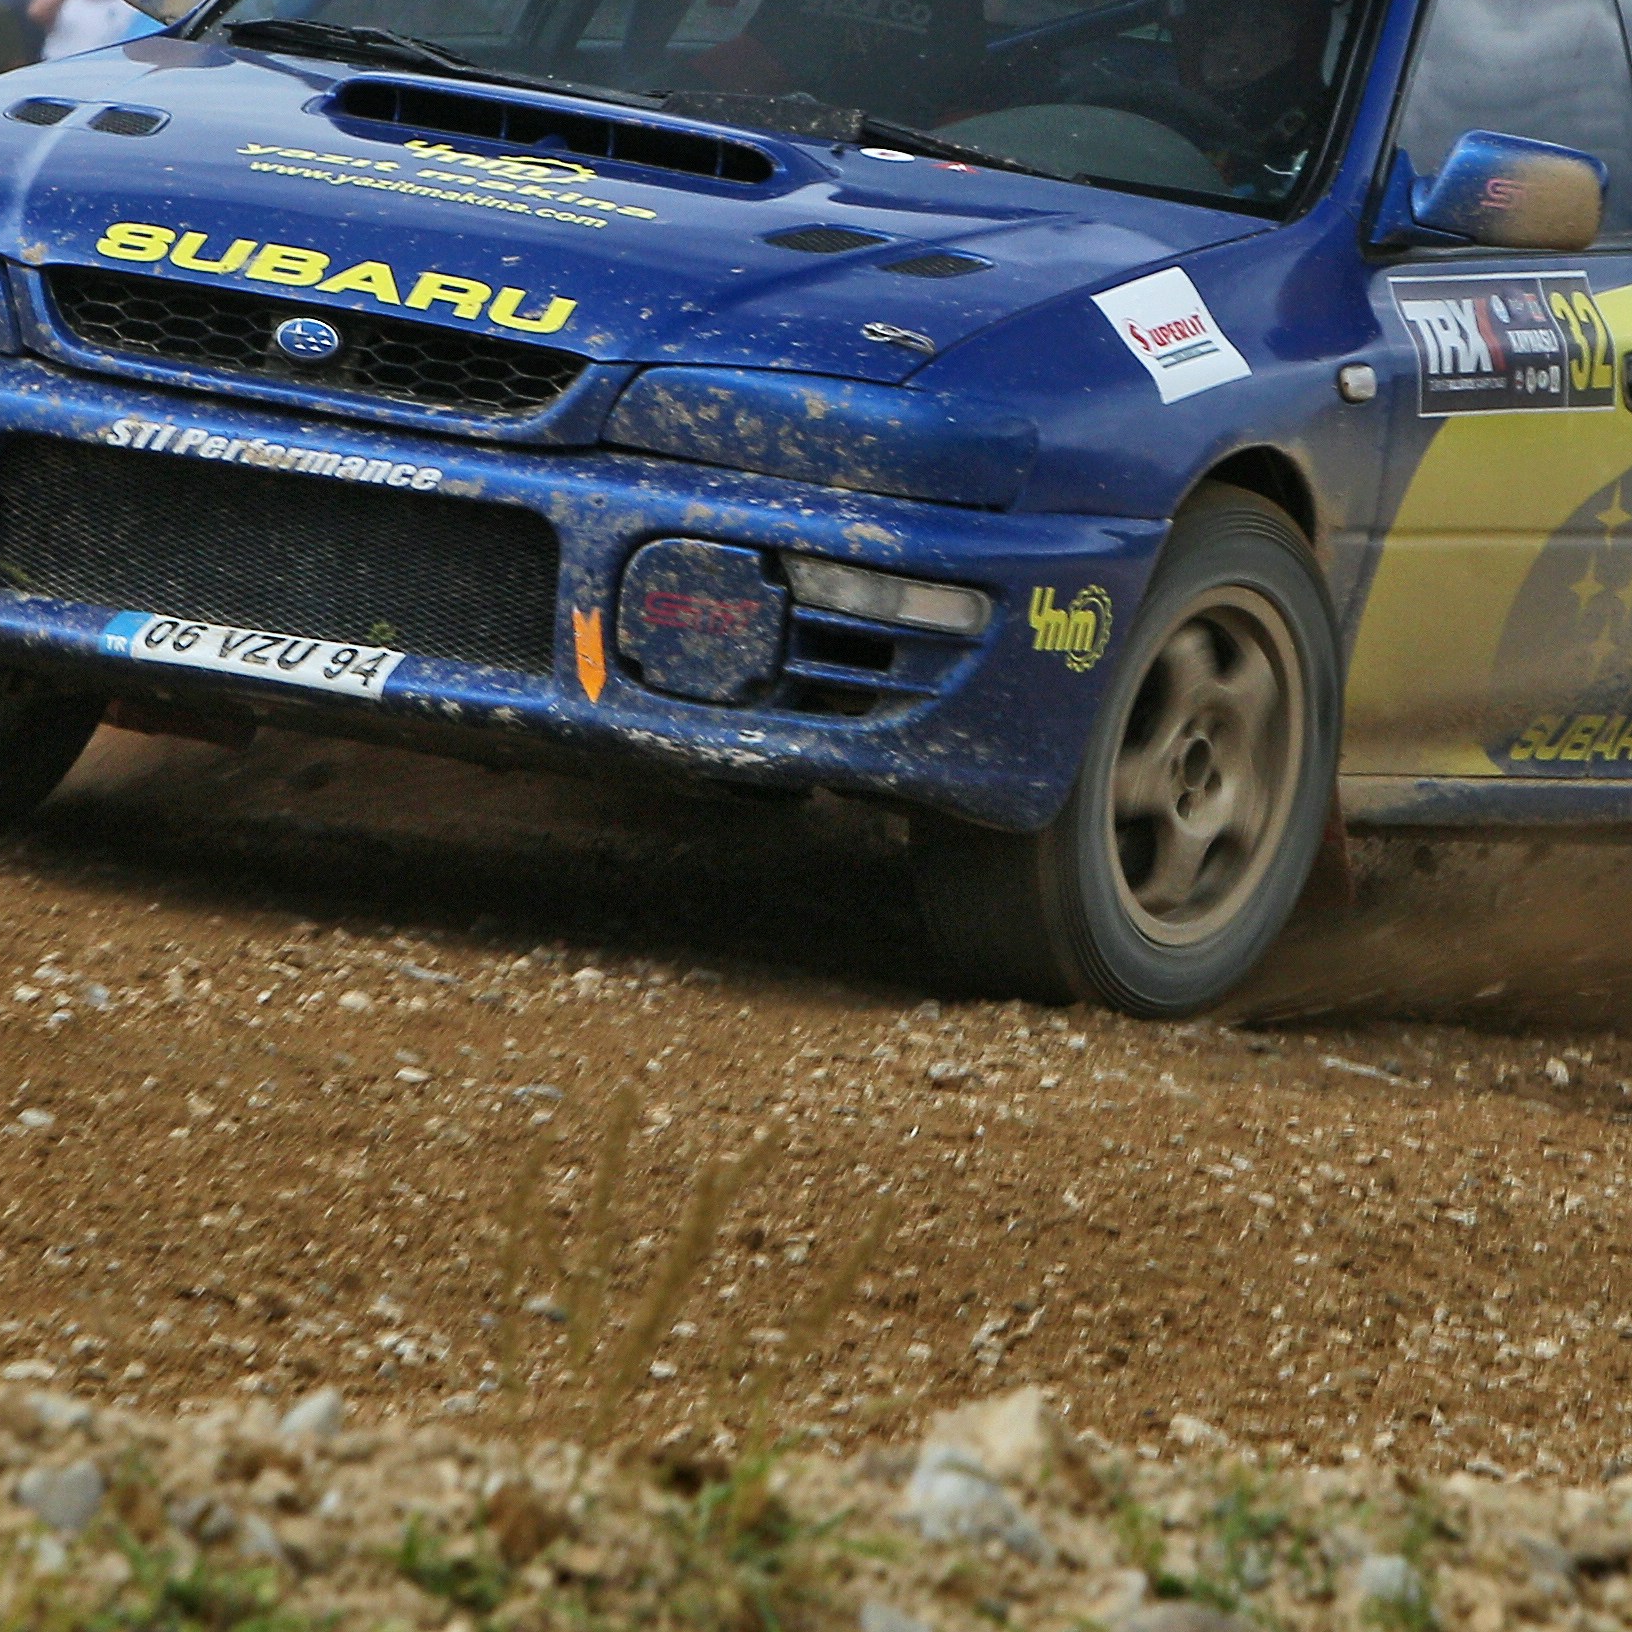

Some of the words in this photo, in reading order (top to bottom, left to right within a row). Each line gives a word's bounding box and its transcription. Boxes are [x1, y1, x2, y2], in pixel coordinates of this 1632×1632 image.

[250, 161, 608, 228] www.yazitmakina.com
[417, 169, 657, 220] makina
[95, 221, 578, 334] SUBARU
[1129, 314, 1208, 353] SUPERLIT
[1399, 298, 1494, 375] TRX
[1549, 289, 1613, 391] 32
[106, 418, 178, 452] STI
[172, 427, 444, 492] Performance
[105, 632, 128, 653] TR
[144, 620, 209, 652] 06
[218, 630, 320, 671] VZU
[324, 647, 389, 687] 94
